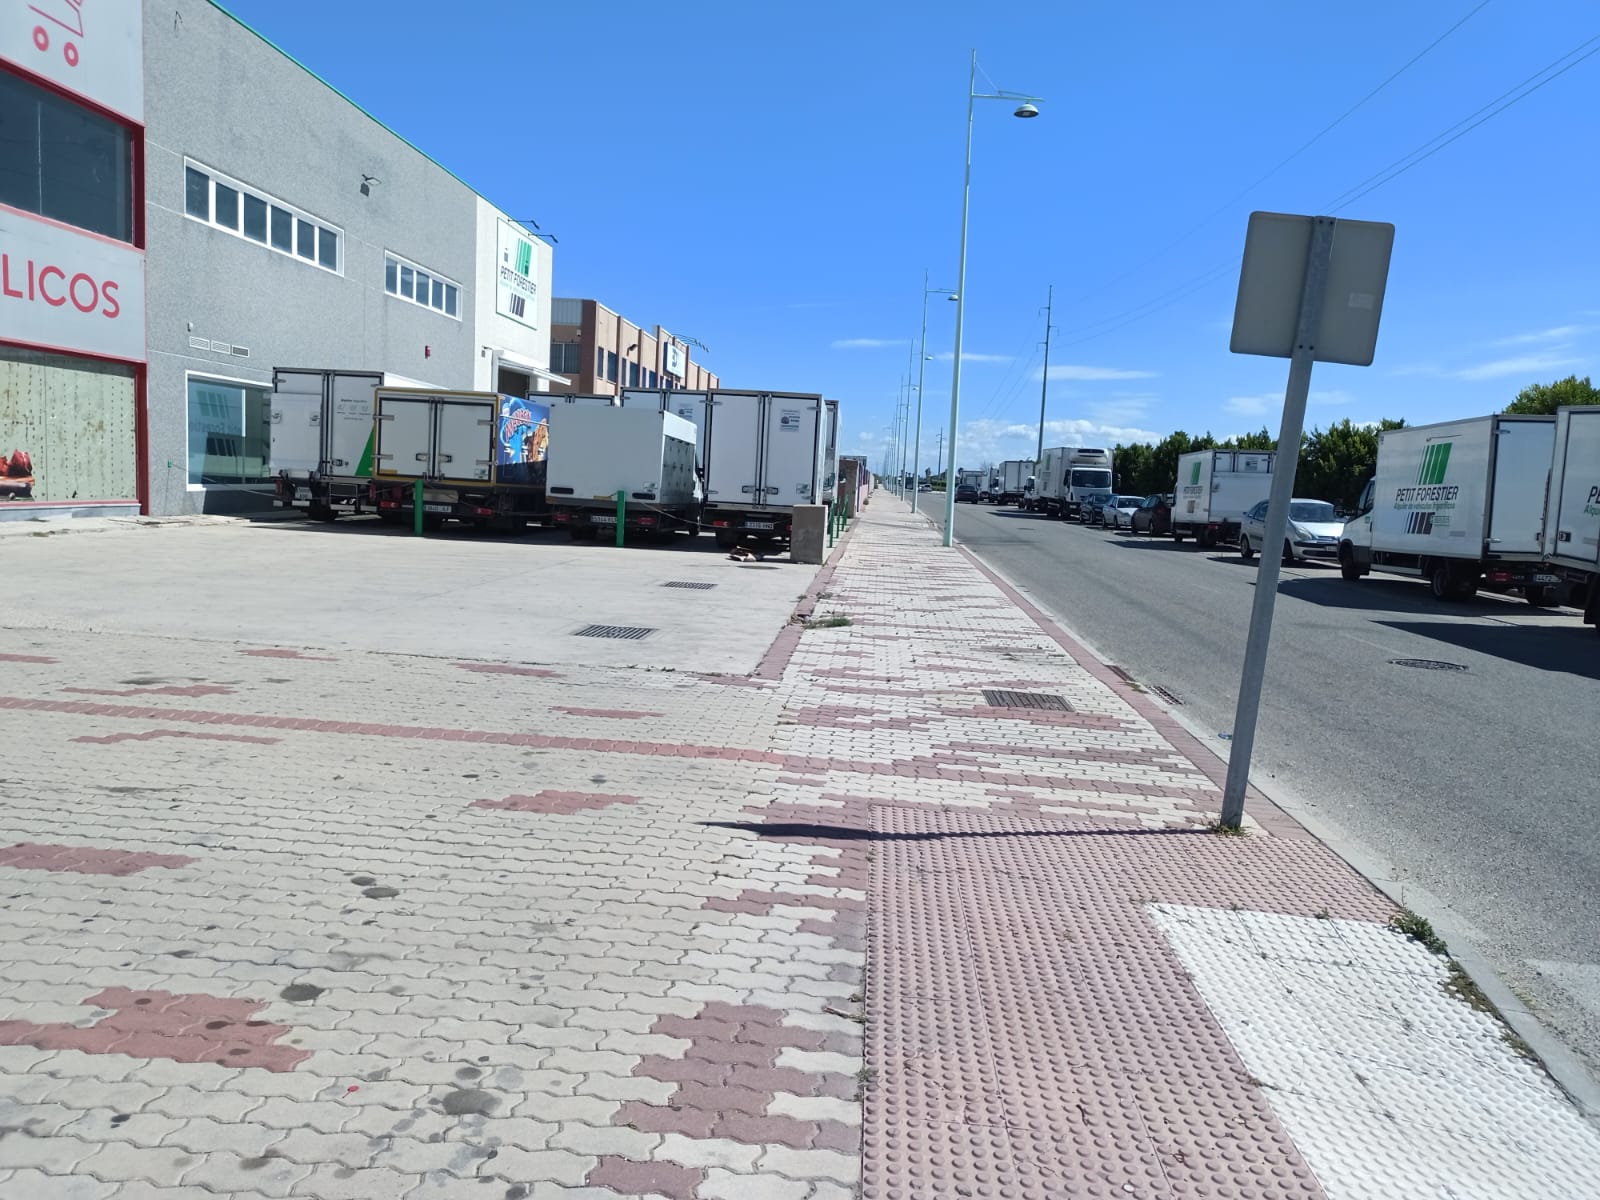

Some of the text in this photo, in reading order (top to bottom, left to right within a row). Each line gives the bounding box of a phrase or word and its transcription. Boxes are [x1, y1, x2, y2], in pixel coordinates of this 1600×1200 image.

[2, 253, 120, 319] LICOS
[1395, 486, 1459, 501] PETIT FORESTIER
